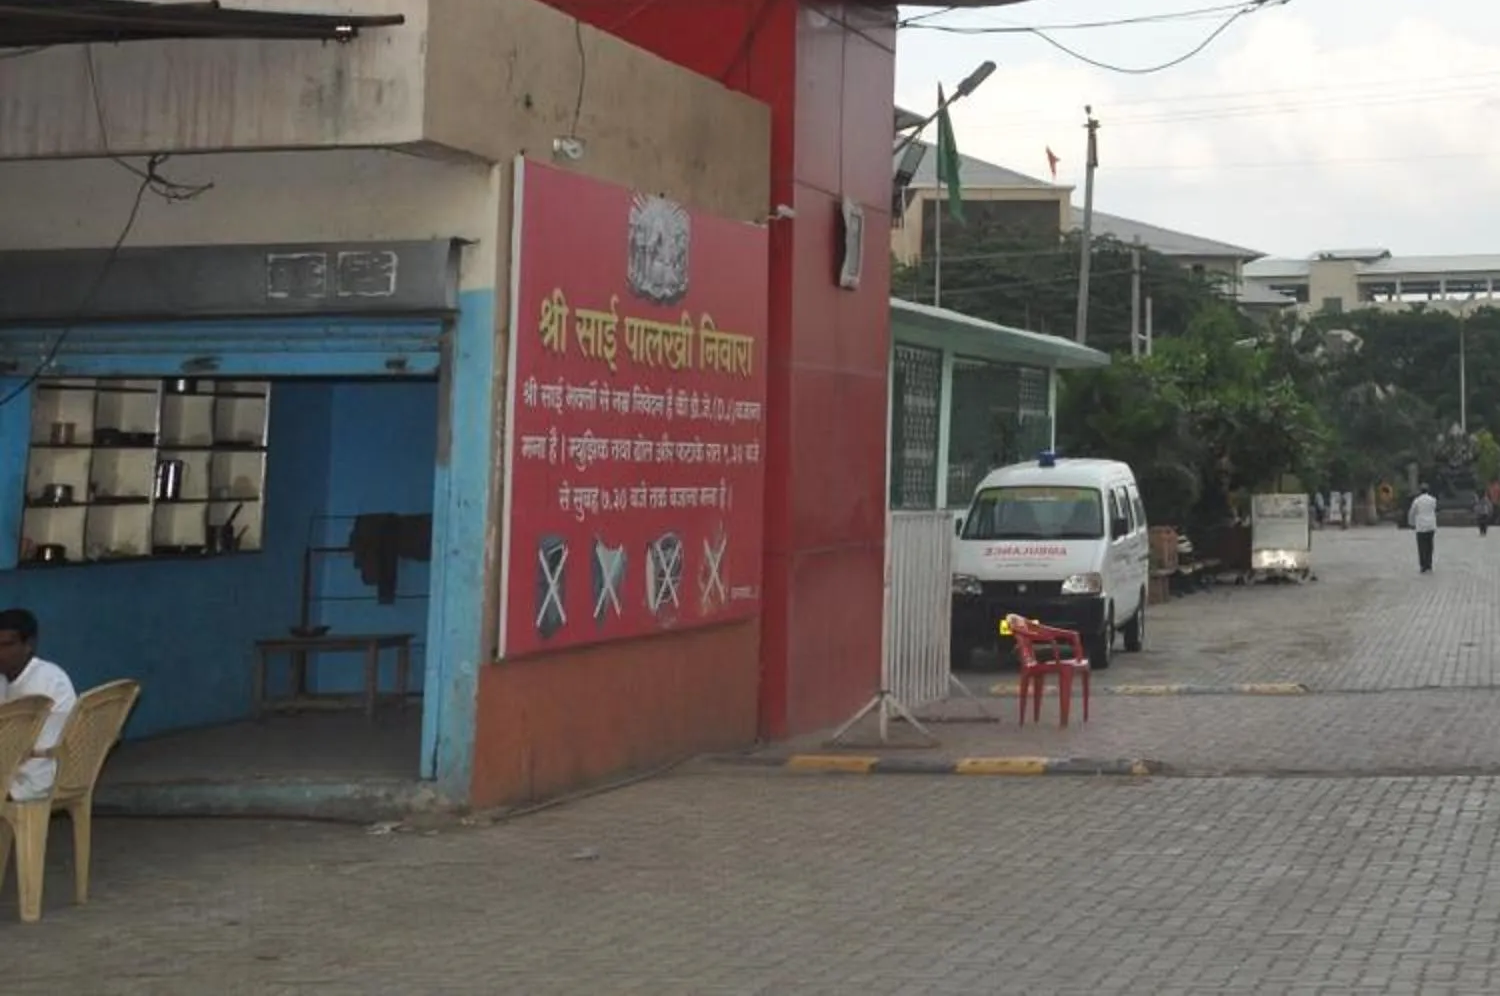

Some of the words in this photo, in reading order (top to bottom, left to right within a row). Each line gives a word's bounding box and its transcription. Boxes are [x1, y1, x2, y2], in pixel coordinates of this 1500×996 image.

[539, 288, 568, 353] श्री
[575, 294, 619, 372] साई
[624, 309, 694, 369] पालखी
[698, 312, 754, 377] निवारा
[522, 376, 537, 408] श्री
[540, 377, 564, 415] साई
